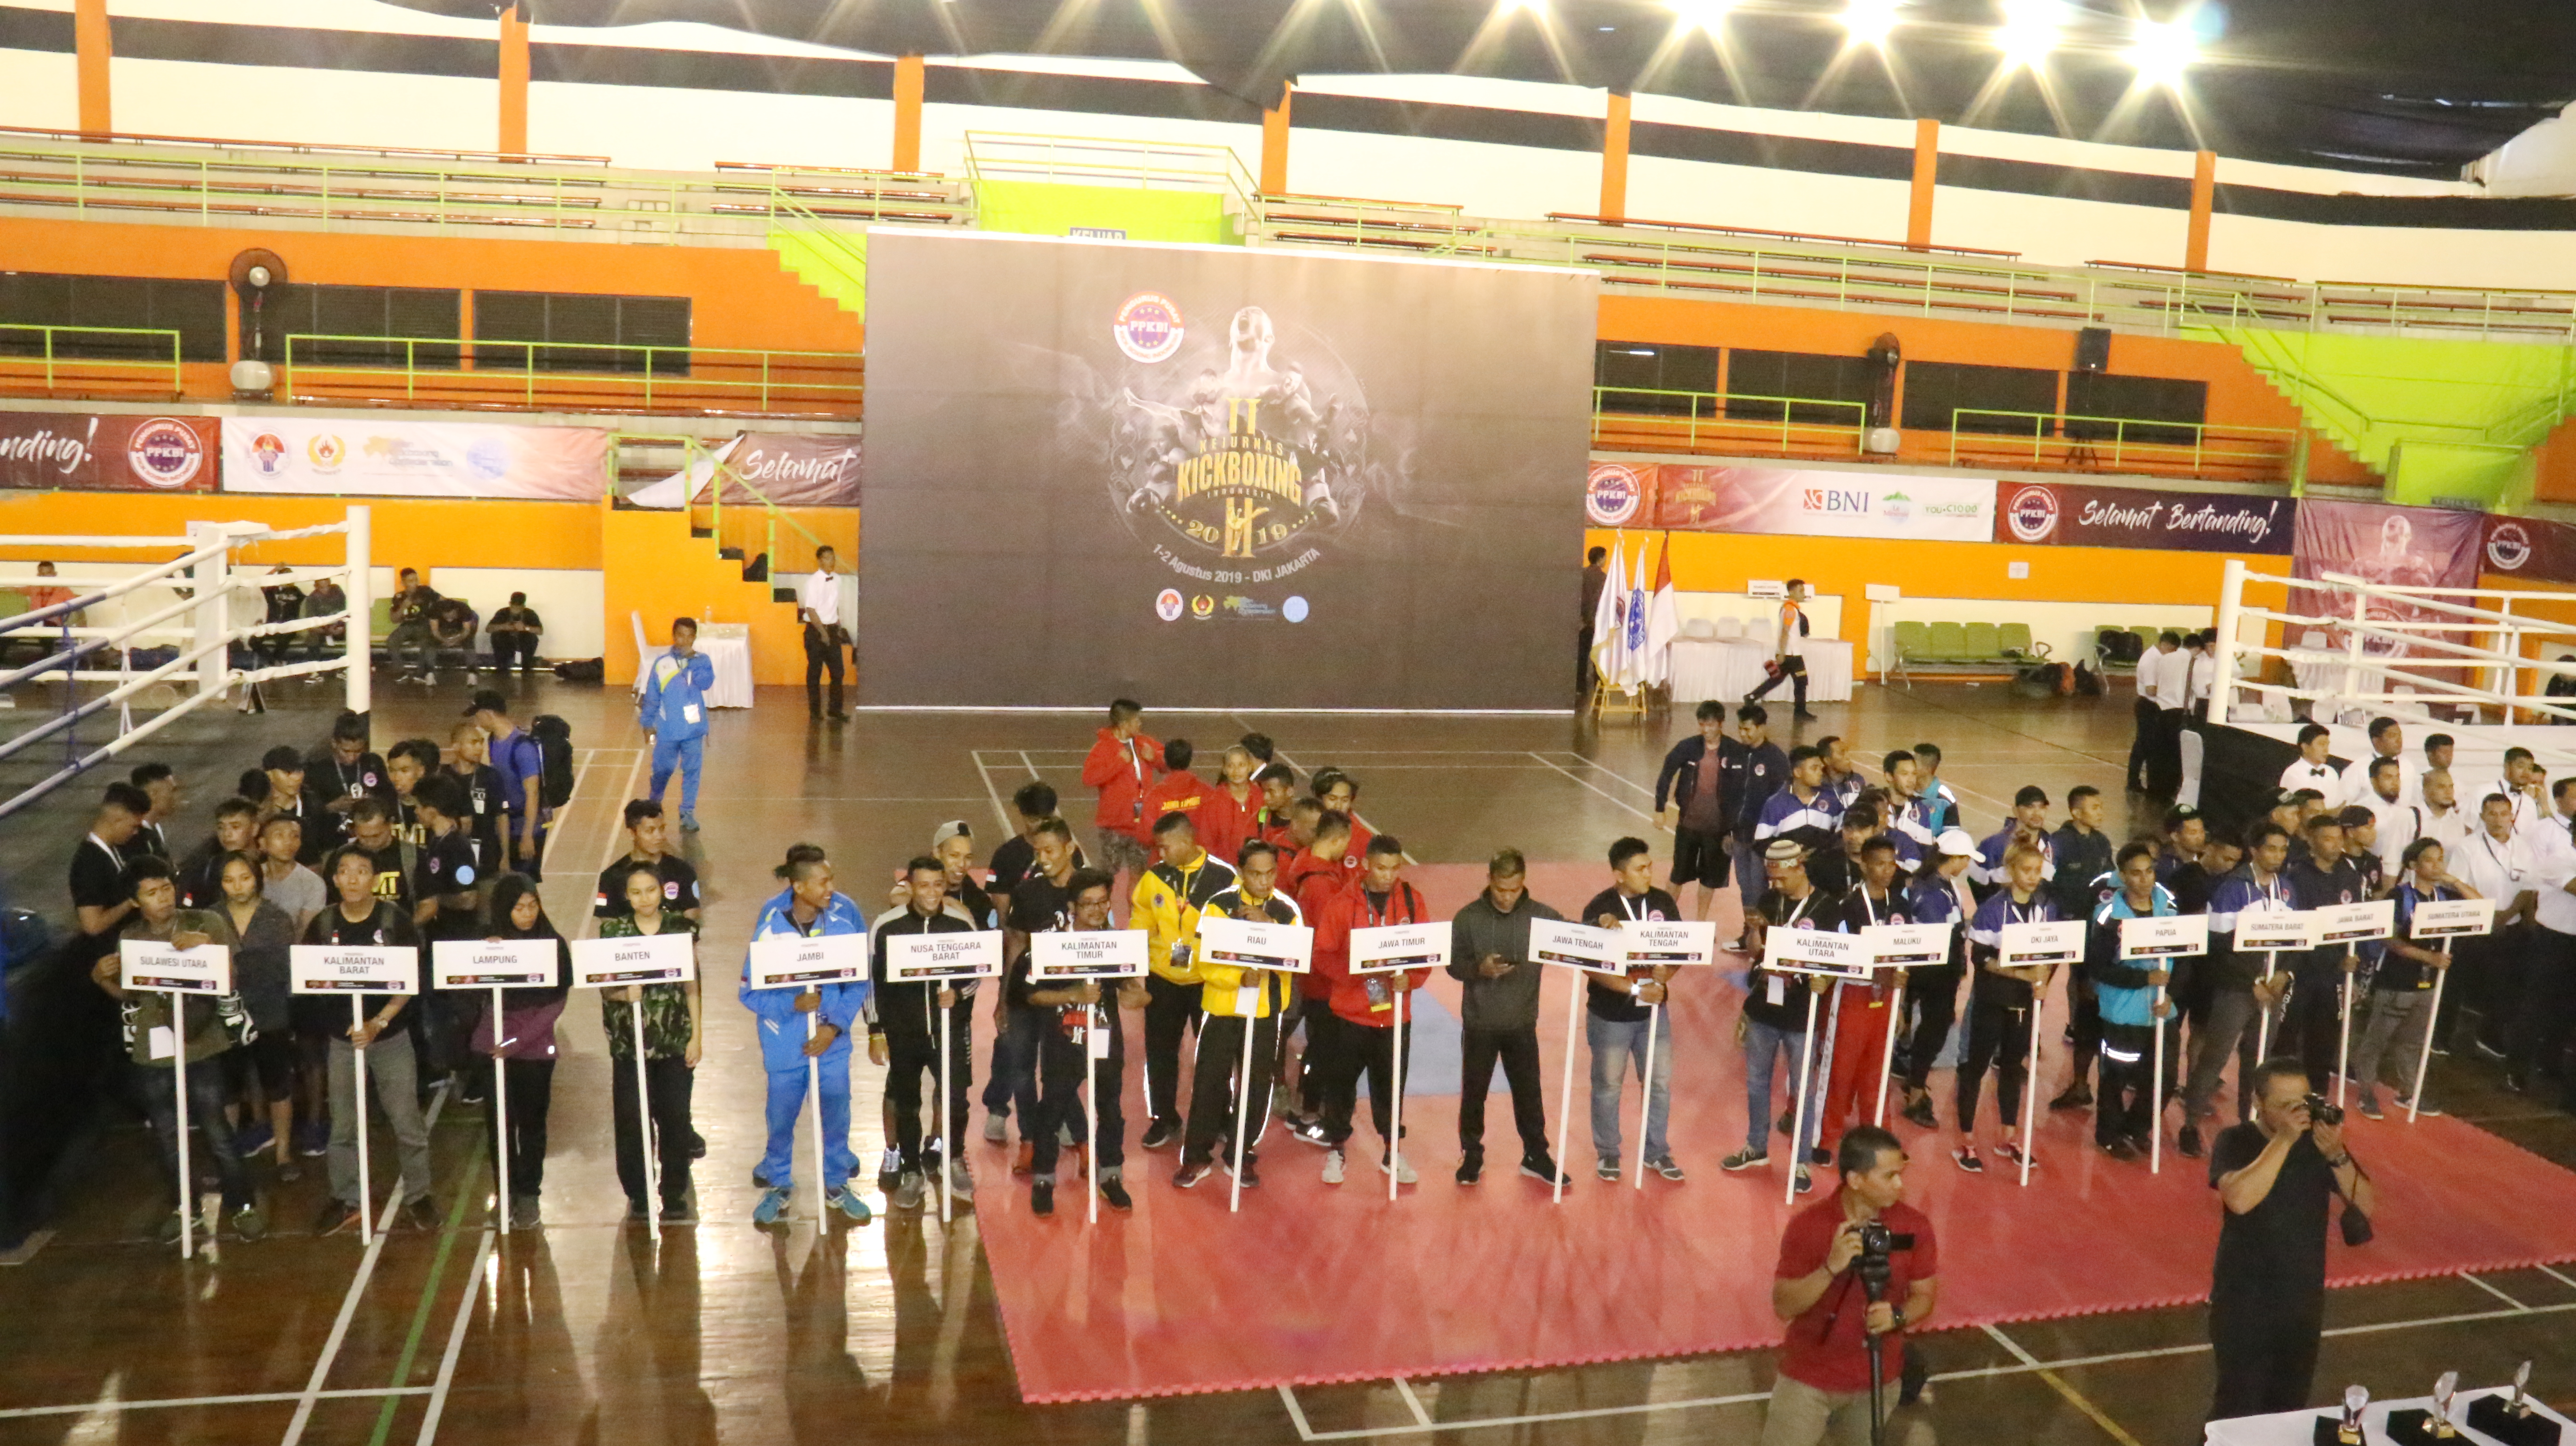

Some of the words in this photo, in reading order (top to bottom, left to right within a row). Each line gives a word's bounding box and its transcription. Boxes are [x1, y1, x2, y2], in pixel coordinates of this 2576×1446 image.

[740, 449, 856, 483] Selamat
[1178, 451, 1302, 506] KICKBOXING
[1207, 487, 1271, 500] INDONESIA
[1827, 490, 1868, 512] BNI
[2079, 500, 2163, 530] Selamat
[2166, 500, 2278, 543] Bertanding!
[1168, 556, 1212, 581] Agustus
[1215, 570, 1242, 583] 2019
[1253, 569, 1272, 582] DKI
[1275, 548, 1320, 578] JAKARTA
[2251, 922, 2284, 931] SUMATERA
[2285, 923, 2304, 931] BARAT
[1640, 931, 1689, 939] KALIMANTAN
[2155, 929, 2177, 937] PAPUA
[1247, 935, 1267, 945] RIAU
[1378, 940, 1400, 948] JAWA
[1401, 937, 1425, 946] TIMUR
[1553, 935, 1573, 945] JAWA
[1575, 938, 1603, 950] TENGAH
[2043, 935, 2059, 943] JAYA
[911, 944, 934, 953] NUSA
[936, 942, 981, 951] TENGGARA
[1062, 941, 1117, 950] KALIMANTAN
[1796, 938, 1849, 951] KALIMANTAN
[615, 951, 650, 961] BANTEN
[797, 952, 824, 961] JAMBI
[933, 952, 960, 961] BARAT
[1077, 951, 1103, 959] TIMUR
[1809, 948, 1835, 958] UTARA
[140, 956, 179, 966] SULAWESI
[182, 957, 208, 968] UTARA
[324, 956, 384, 965] KALIMANTAN
[473, 955, 517, 964] LAMPUNG
[339, 966, 370, 974] BARAT
